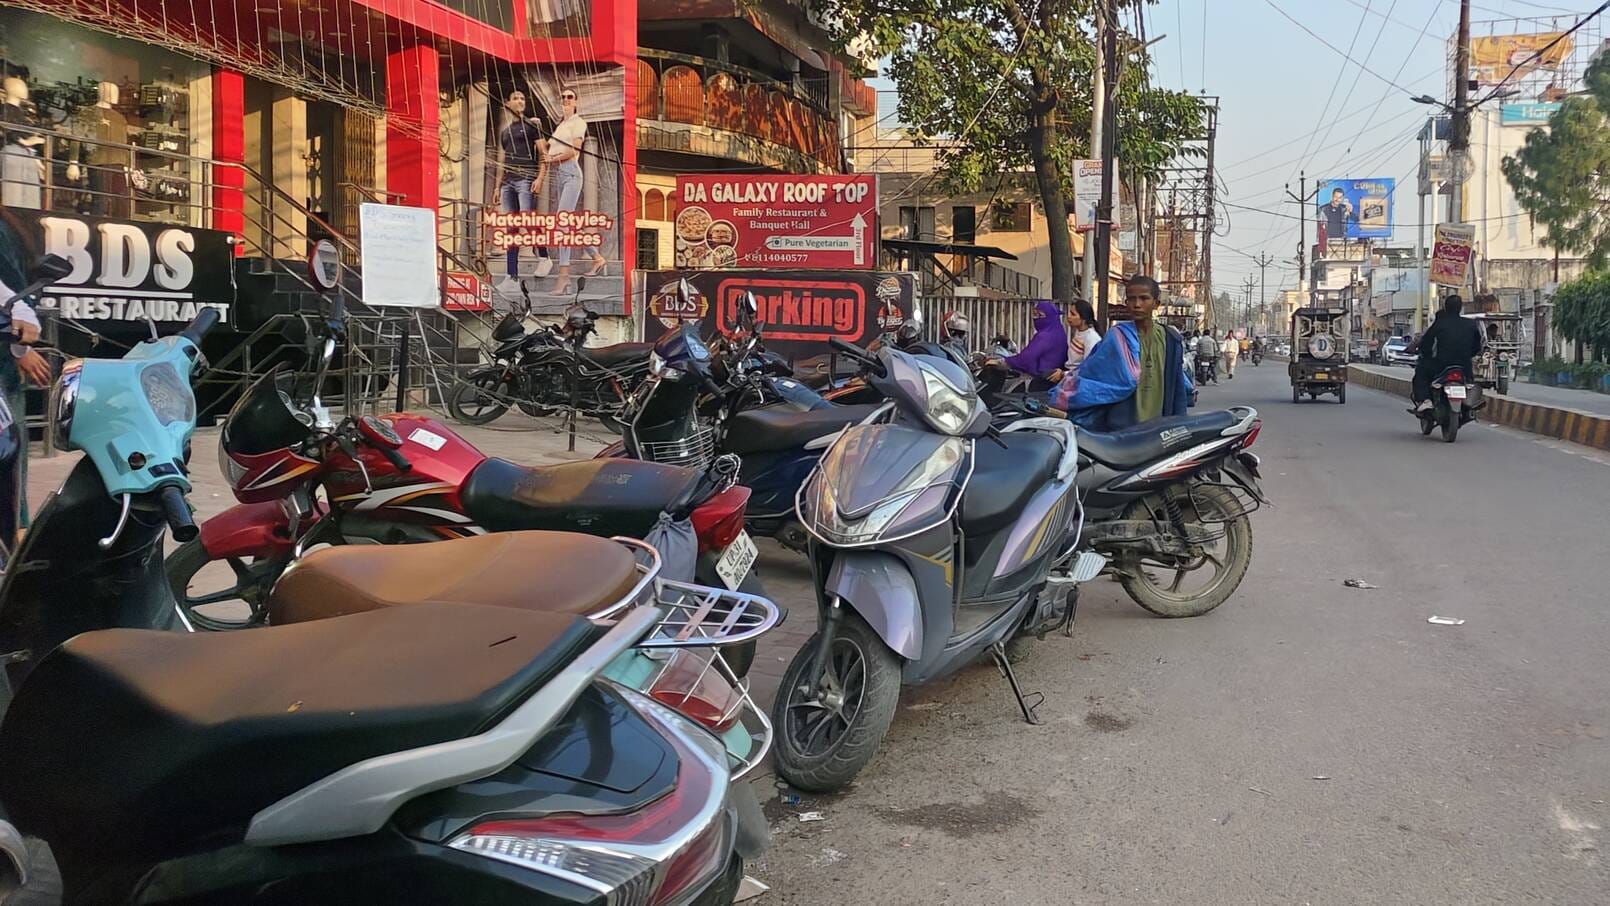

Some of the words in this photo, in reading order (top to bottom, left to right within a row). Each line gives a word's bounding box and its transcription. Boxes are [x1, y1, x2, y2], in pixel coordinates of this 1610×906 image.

[1084, 161, 1103, 169] GRAN
[684, 182, 707, 204] DA
[711, 182, 778, 204] GALAXY
[783, 182, 828, 204] ROOF
[832, 182, 868, 204] TOP
[733, 208, 763, 218] Family
[766, 208, 817, 217] Restaurant
[820, 208, 827, 217] &
[484, 212, 556, 229] Matching
[558, 212, 612, 228] Styles,
[750, 221, 789, 230] Banquet
[791, 221, 810, 230] Hall
[494, 231, 550, 248] Special
[554, 231, 602, 246] Prices
[785, 239, 803, 247] Pure
[805, 239, 848, 249] Vegetarian
[40, 216, 195, 290] BDS
